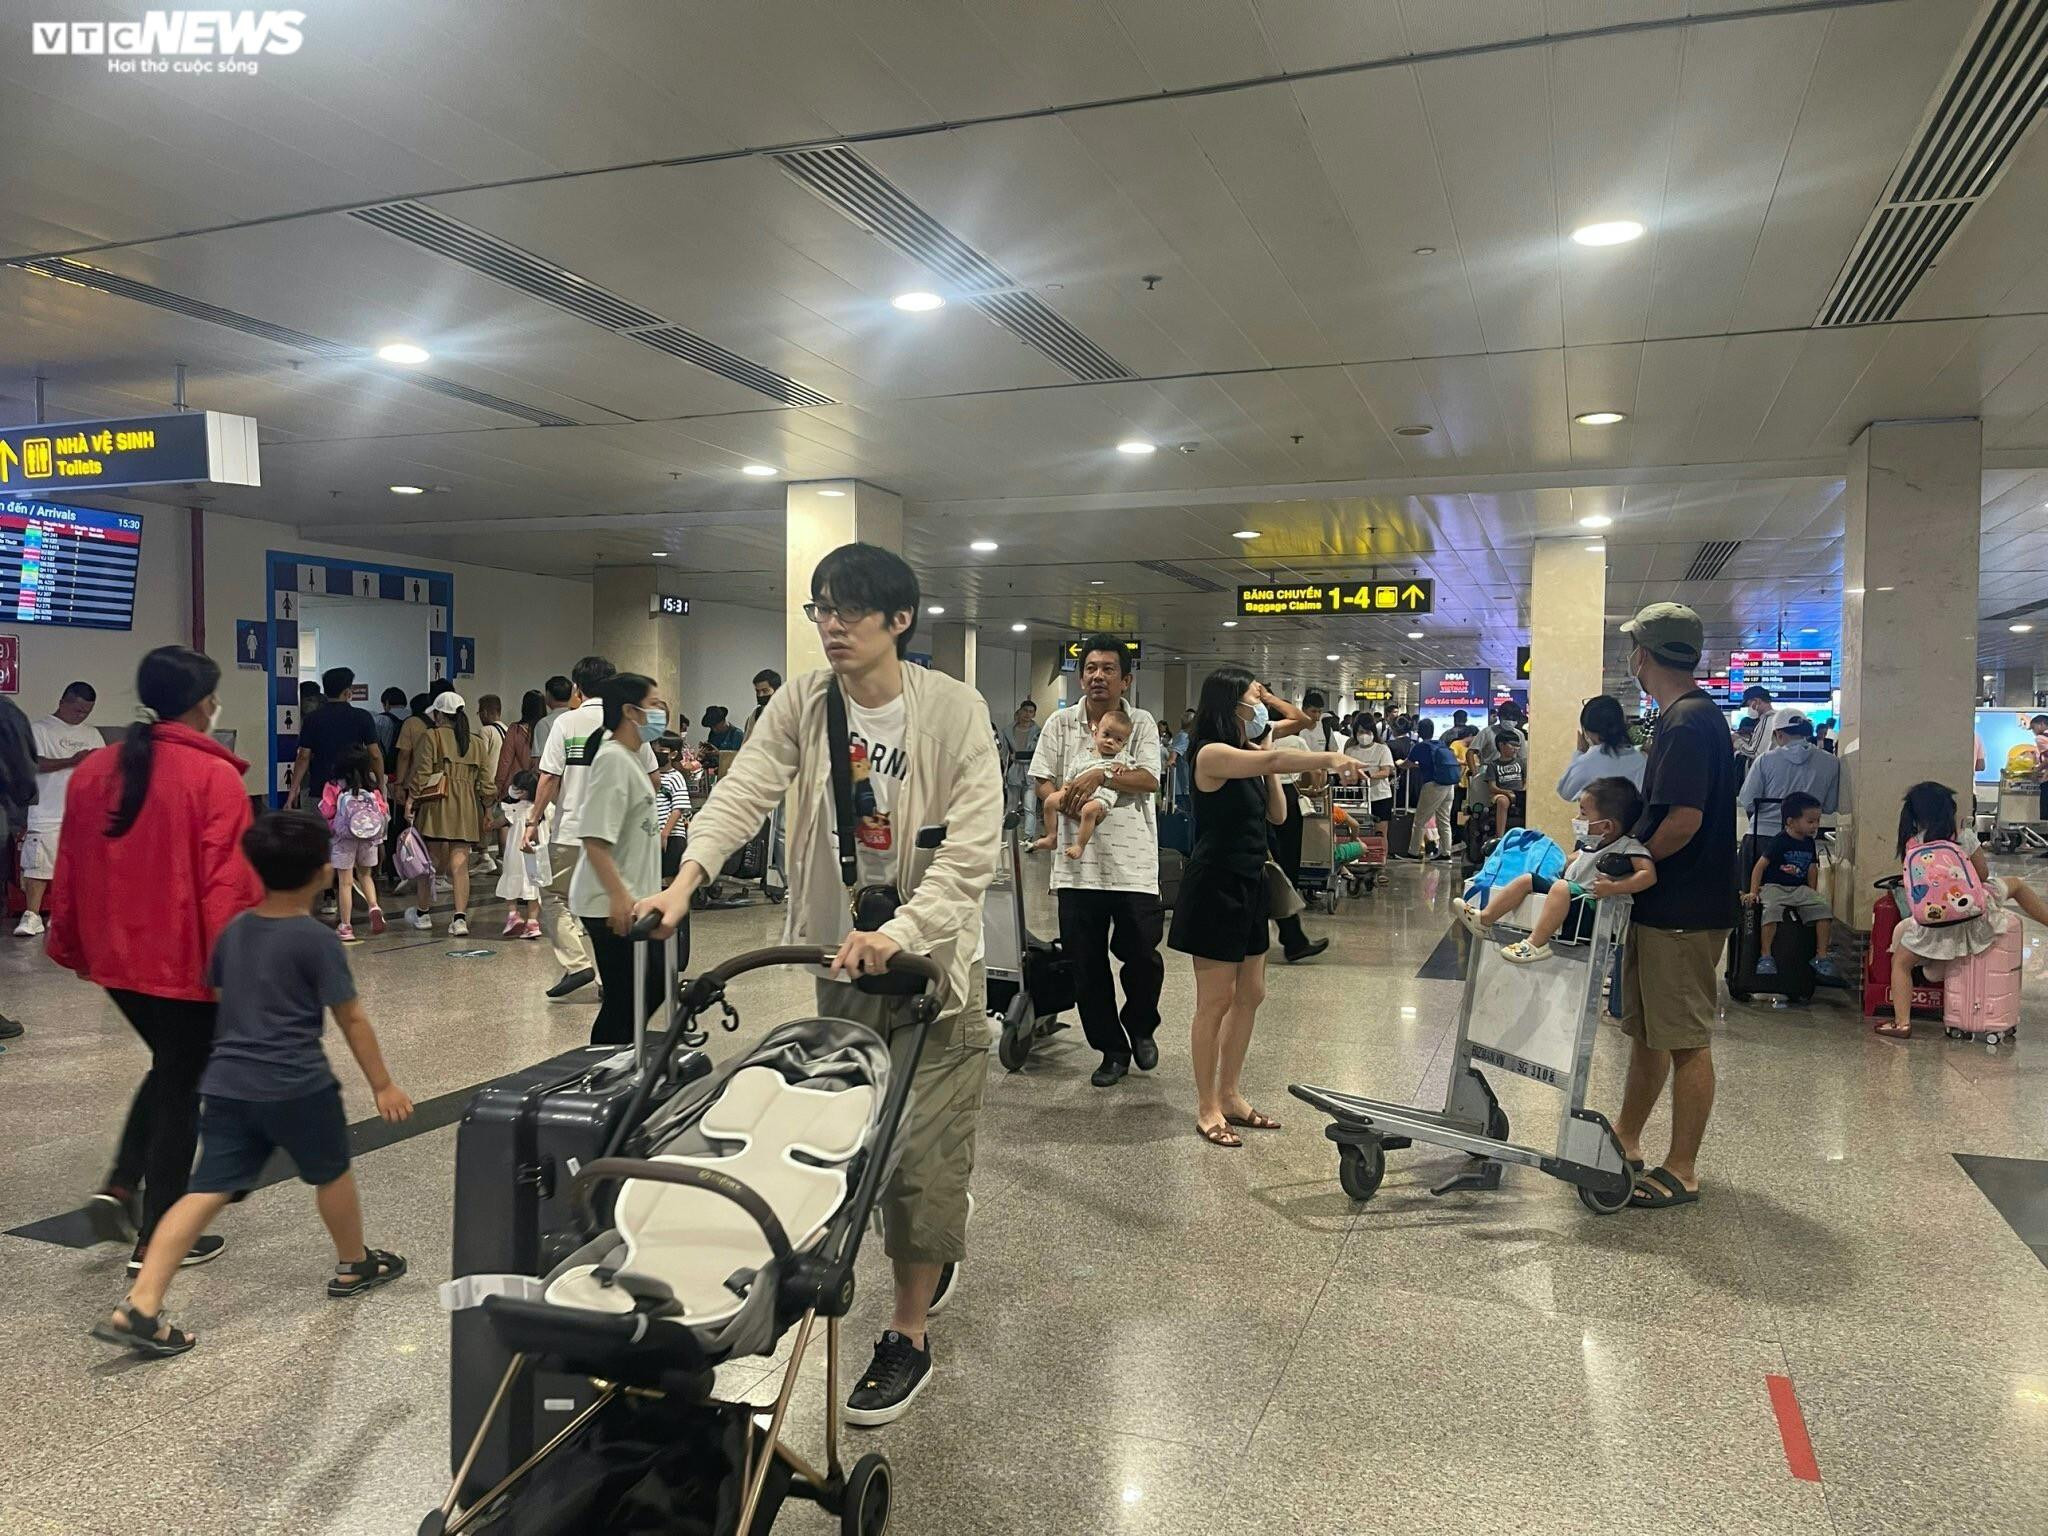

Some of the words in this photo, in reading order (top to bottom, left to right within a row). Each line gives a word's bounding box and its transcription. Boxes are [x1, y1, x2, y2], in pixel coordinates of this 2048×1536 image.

[56, 432, 90, 455] NHÀ
[91, 430, 113, 455] VỆ
[116, 431, 155, 451] SINH
[57, 459, 103, 476] Toilets
[7, 501, 28, 515] đến
[36, 506, 76, 520] Arrivals
[118, 518, 140, 529] 15:30
[663, 598, 689, 613] 15:31
[1243, 588, 1275, 600] BĂNG
[1328, 586, 1371, 609] 1-4
[1245, 602, 1288, 612] Baggage
[1289, 600, 1322, 610] Claims
